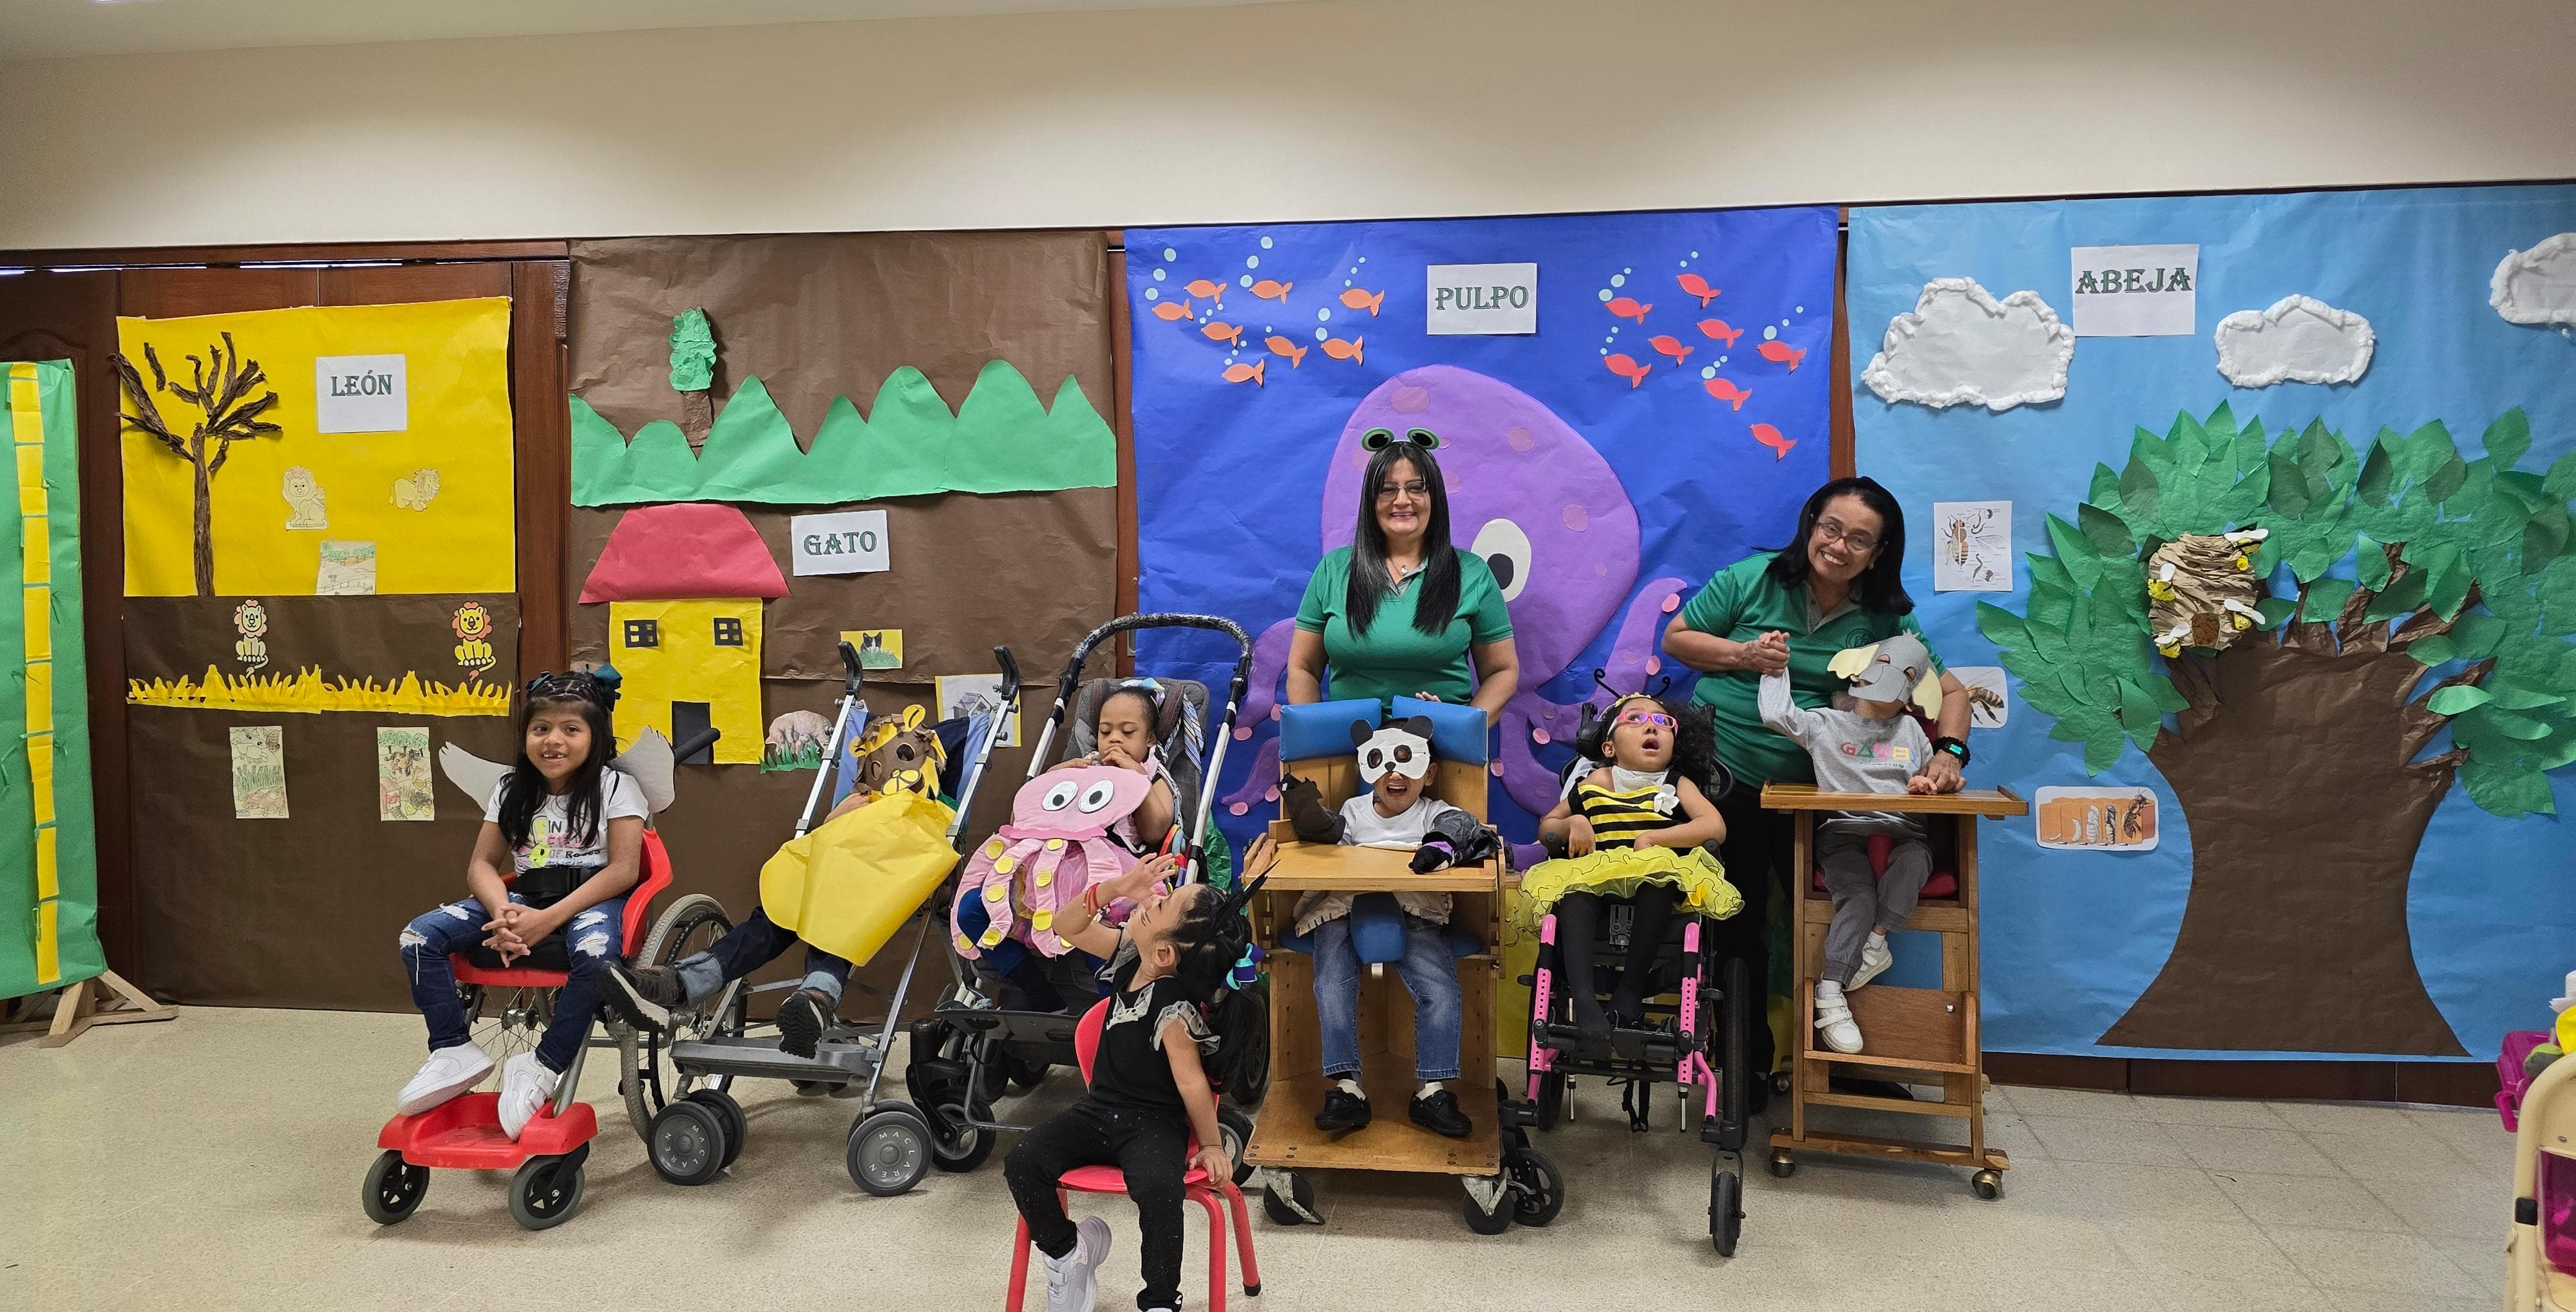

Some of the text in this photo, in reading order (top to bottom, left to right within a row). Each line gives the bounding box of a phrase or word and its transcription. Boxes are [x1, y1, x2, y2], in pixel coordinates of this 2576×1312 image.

[2075, 267, 2193, 294] ABEJA
[1435, 285, 1529, 310] PULPO
[330, 369, 393, 397] LEÓN
[804, 531, 877, 556] GATO
[548, 820, 562, 833] IN
[664, 1125, 706, 1168] MACLAREN
[869, 1131, 915, 1178] MACLAREN
